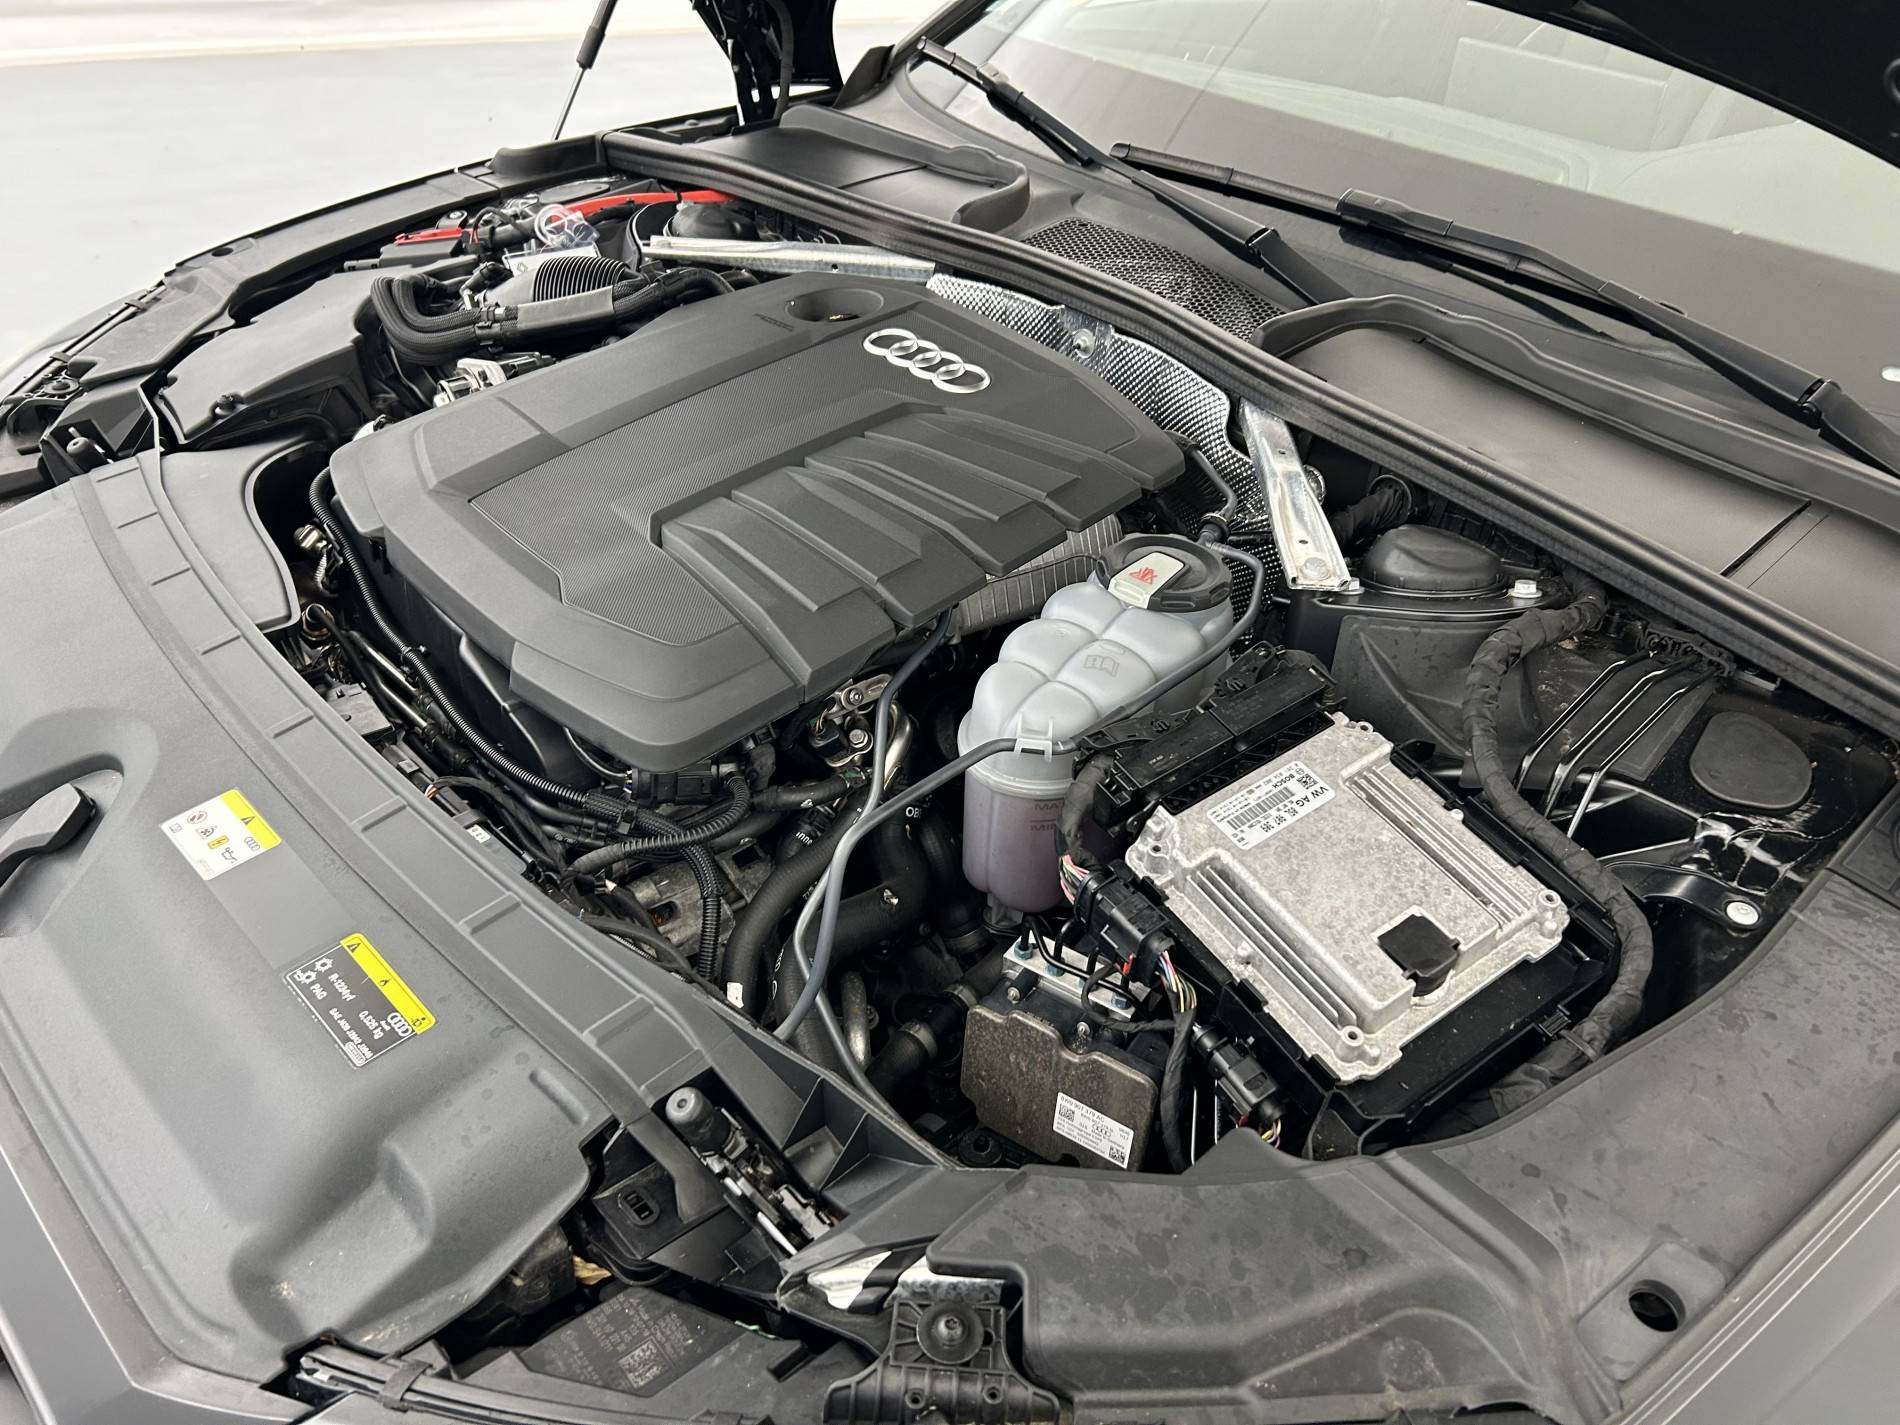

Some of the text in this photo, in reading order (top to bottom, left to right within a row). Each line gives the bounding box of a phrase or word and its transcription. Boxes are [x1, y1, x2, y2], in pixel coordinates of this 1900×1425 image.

[1272, 774, 1295, 788] BOSCH
[1295, 786, 1328, 807] VW AG
[310, 983, 328, 1000] PAG
[328, 973, 356, 1002] R-1234yf
